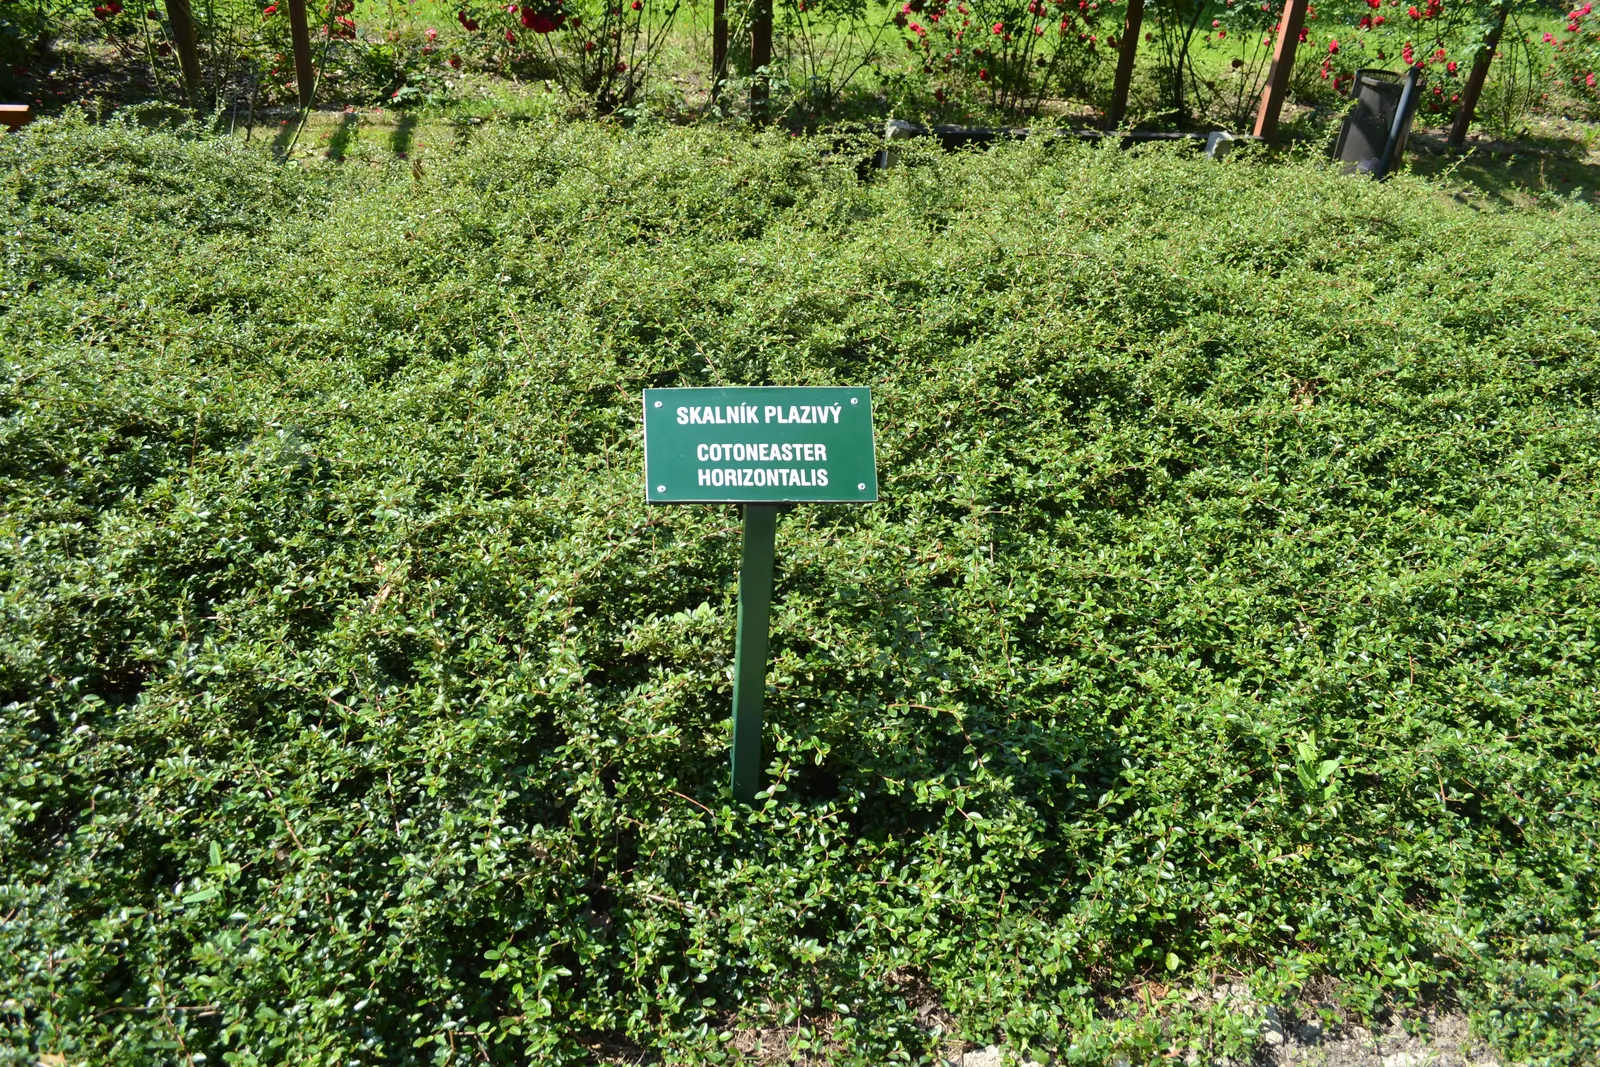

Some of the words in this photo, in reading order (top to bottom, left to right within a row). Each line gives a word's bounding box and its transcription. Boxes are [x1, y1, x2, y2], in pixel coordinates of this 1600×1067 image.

[676, 402, 759, 425] SKALNÍK
[764, 402, 842, 424] PLAZIVÝ
[696, 443, 828, 462] COTONEASTER
[697, 468, 829, 487] HORIZONTALIS
